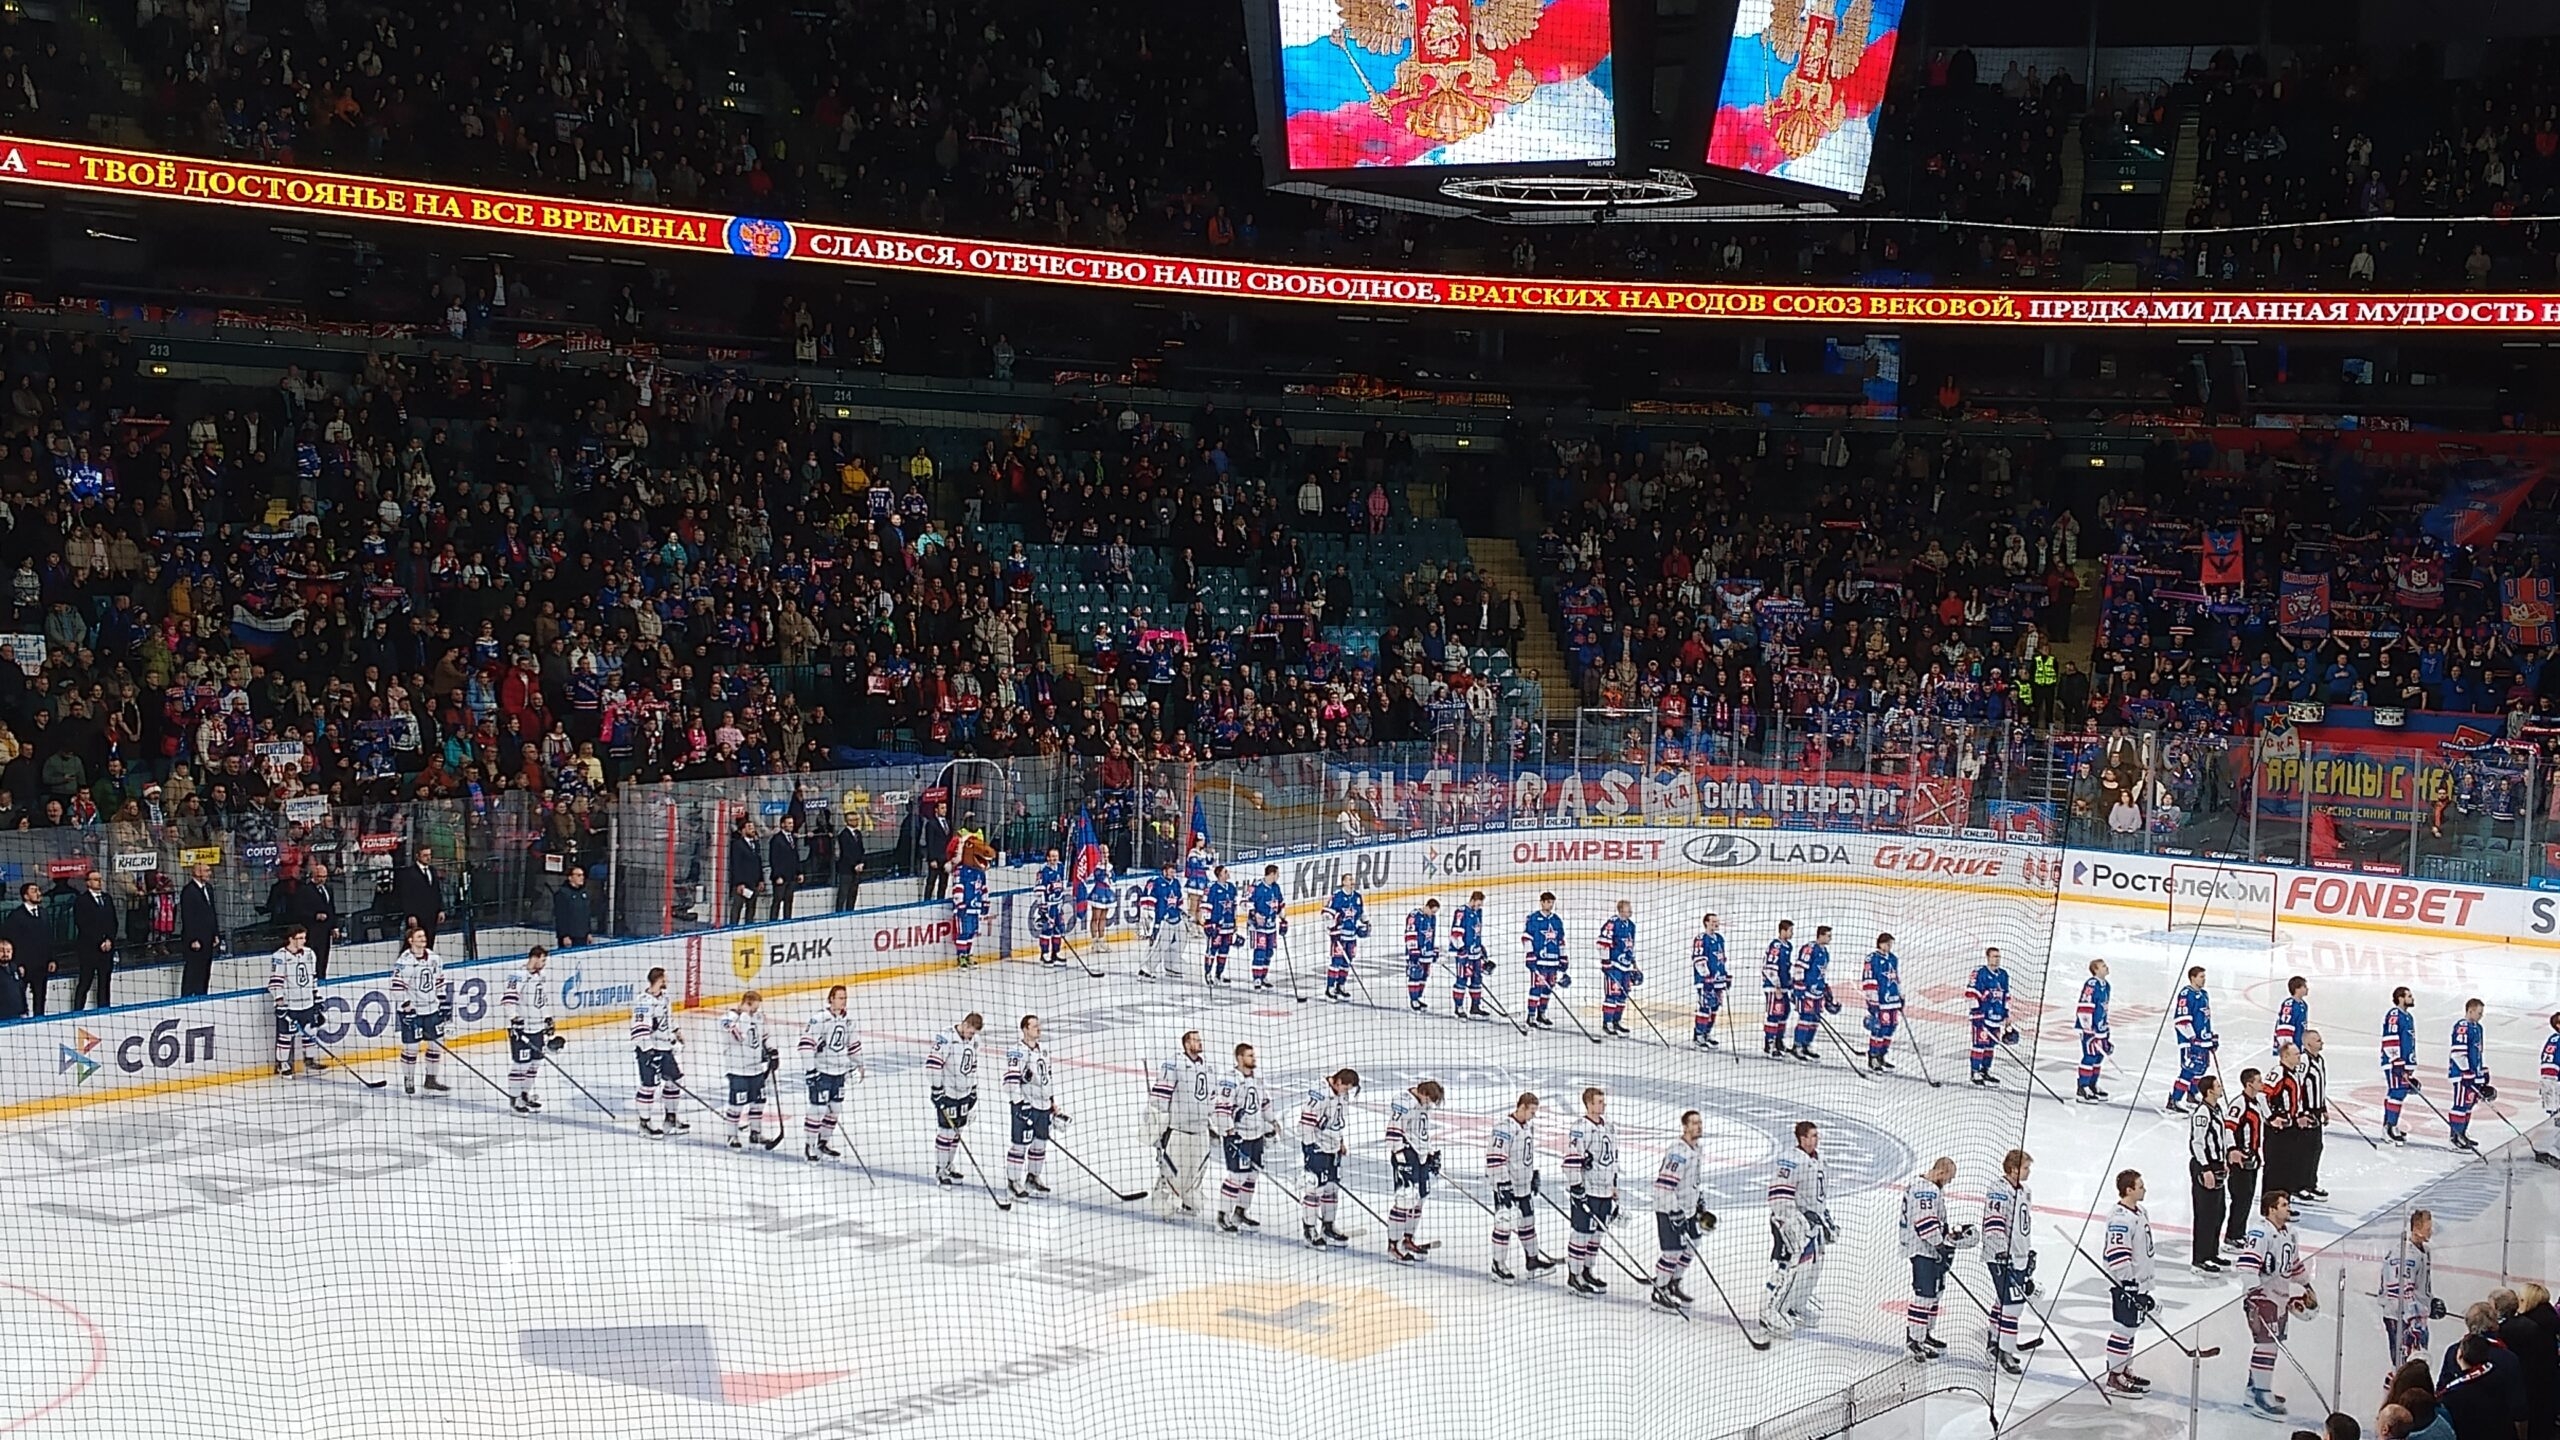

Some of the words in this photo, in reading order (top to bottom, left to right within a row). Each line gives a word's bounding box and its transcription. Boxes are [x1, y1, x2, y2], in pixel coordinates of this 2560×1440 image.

[79, 154, 177, 189] ТВОЁ
[183, 168, 405, 213] ДОСТОЯНЬЕ
[413, 193, 464, 219] НА
[470, 198, 536, 226] ВСЕ
[540, 206, 707, 243] ВРЕМЕНА!
[809, 234, 963, 269] СЛАВЬСЯ,
[969, 248, 1147, 281] ОТЕЧЕСТВО
[1152, 264, 1241, 289] НАШЕ
[1246, 272, 1442, 302] СВОБОДНОЕ,
[1447, 283, 1610, 307] БРАТСКИХ
[1617, 290, 1766, 315] НАРОДОВ
[1772, 294, 1863, 316] СОЮЗ
[1868, 295, 2022, 320] ВЕКОВОЙ,
[2029, 299, 2202, 322] ПРЕДКАМИ
[2209, 302, 2349, 325] ДАННАЯ
[2354, 303, 2535, 326] МУДРОСТЬ
[149, 343, 170, 357] 213
[2266, 736, 2295, 753] СКА
[1703, 780, 1754, 810] СКА
[1762, 783, 1903, 817] ПЕТЕРБУРГ
[246, 846, 278, 857] согаз
[1443, 842, 1481, 875] сбп
[1513, 839, 1665, 863] OLIMPBET
[1769, 842, 1850, 864] LADA
[1293, 850, 1392, 900] KHL.RU
[2093, 864, 2270, 902] Ростелеком
[2285, 876, 2485, 926] FONBET
[2531, 897, 2560, 934] S
[874, 913, 998, 952] OLIMPT
[770, 937, 832, 967] БАНК
[117, 1018, 215, 1073] сбп
